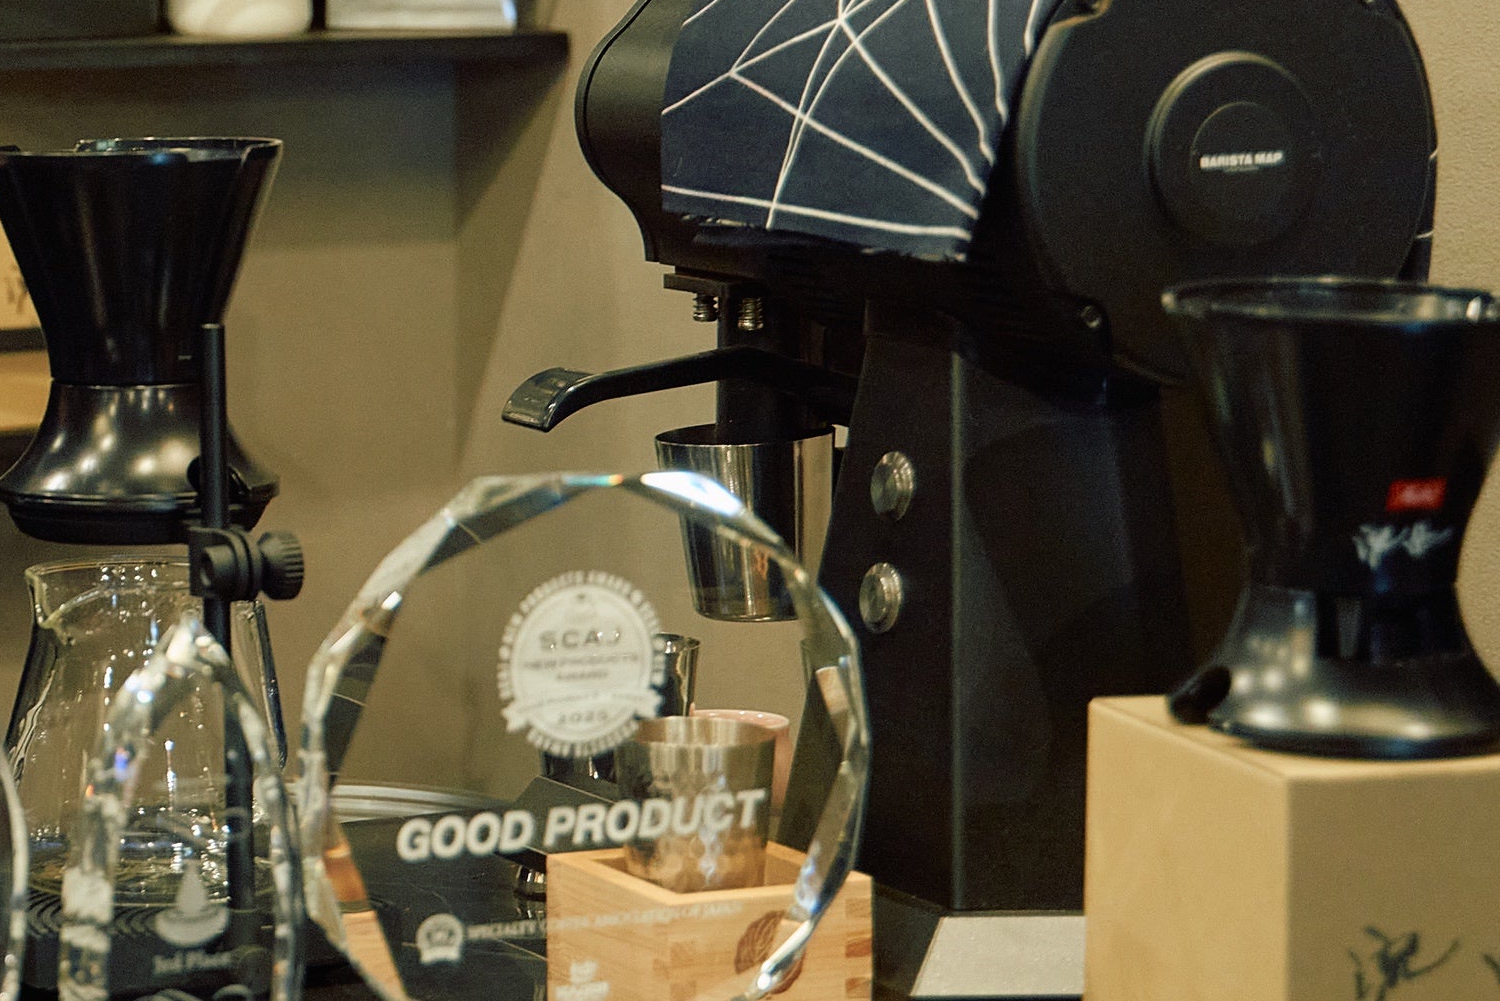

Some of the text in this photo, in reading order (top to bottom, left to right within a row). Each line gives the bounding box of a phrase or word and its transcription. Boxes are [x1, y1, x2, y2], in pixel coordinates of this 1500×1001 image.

[1200, 153, 1253, 169] BARISTA
[396, 788, 768, 863] GOOD PRODUCT
